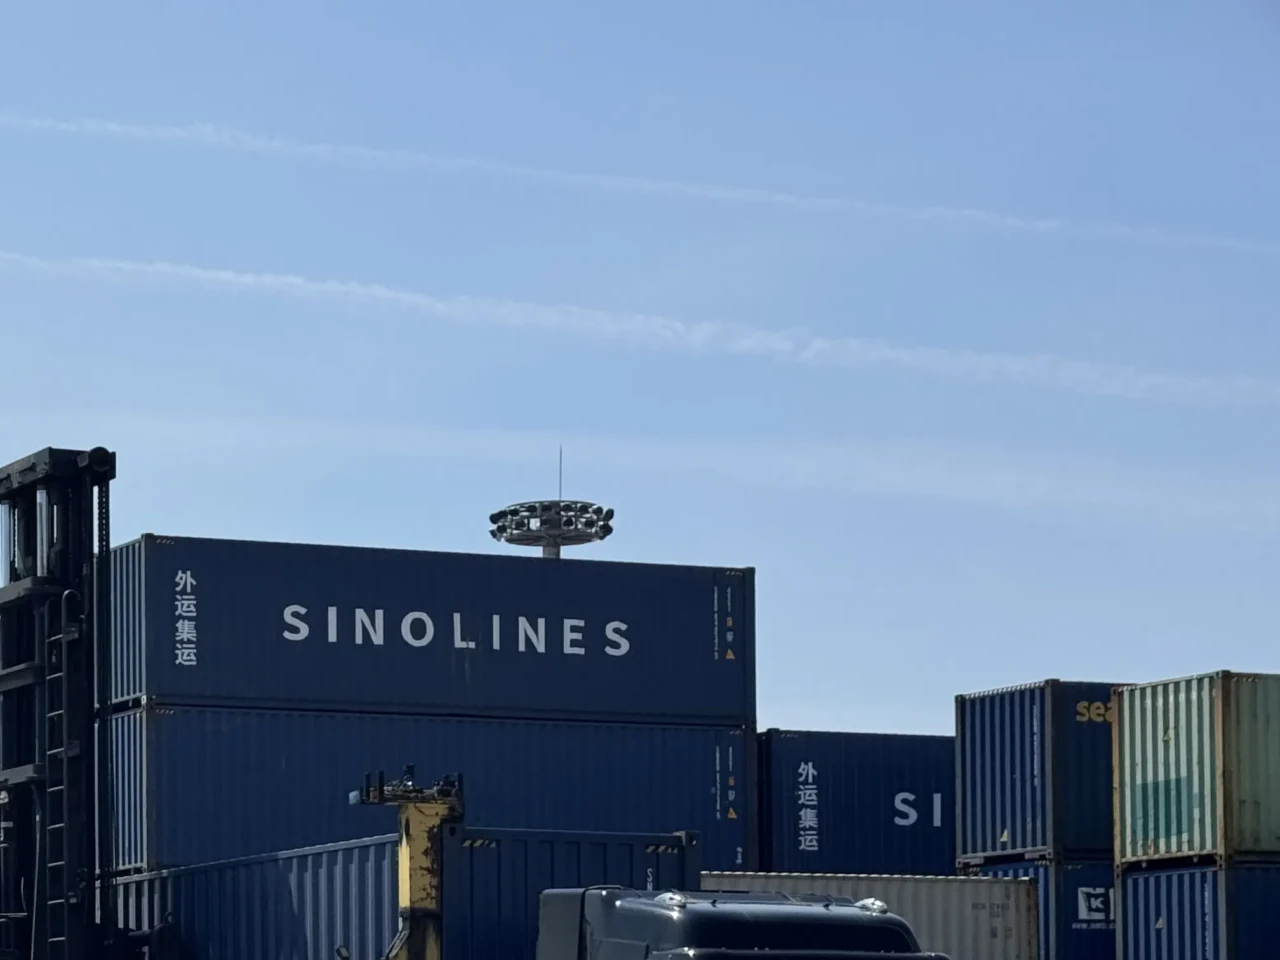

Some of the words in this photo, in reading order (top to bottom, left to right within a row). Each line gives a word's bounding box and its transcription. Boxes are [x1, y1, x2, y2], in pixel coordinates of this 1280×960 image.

[174, 569, 198, 666] 外运集运
[281, 603, 631, 657] SINOLINES
[797, 761, 820, 852] 外运集运
[893, 791, 943, 828] SI
